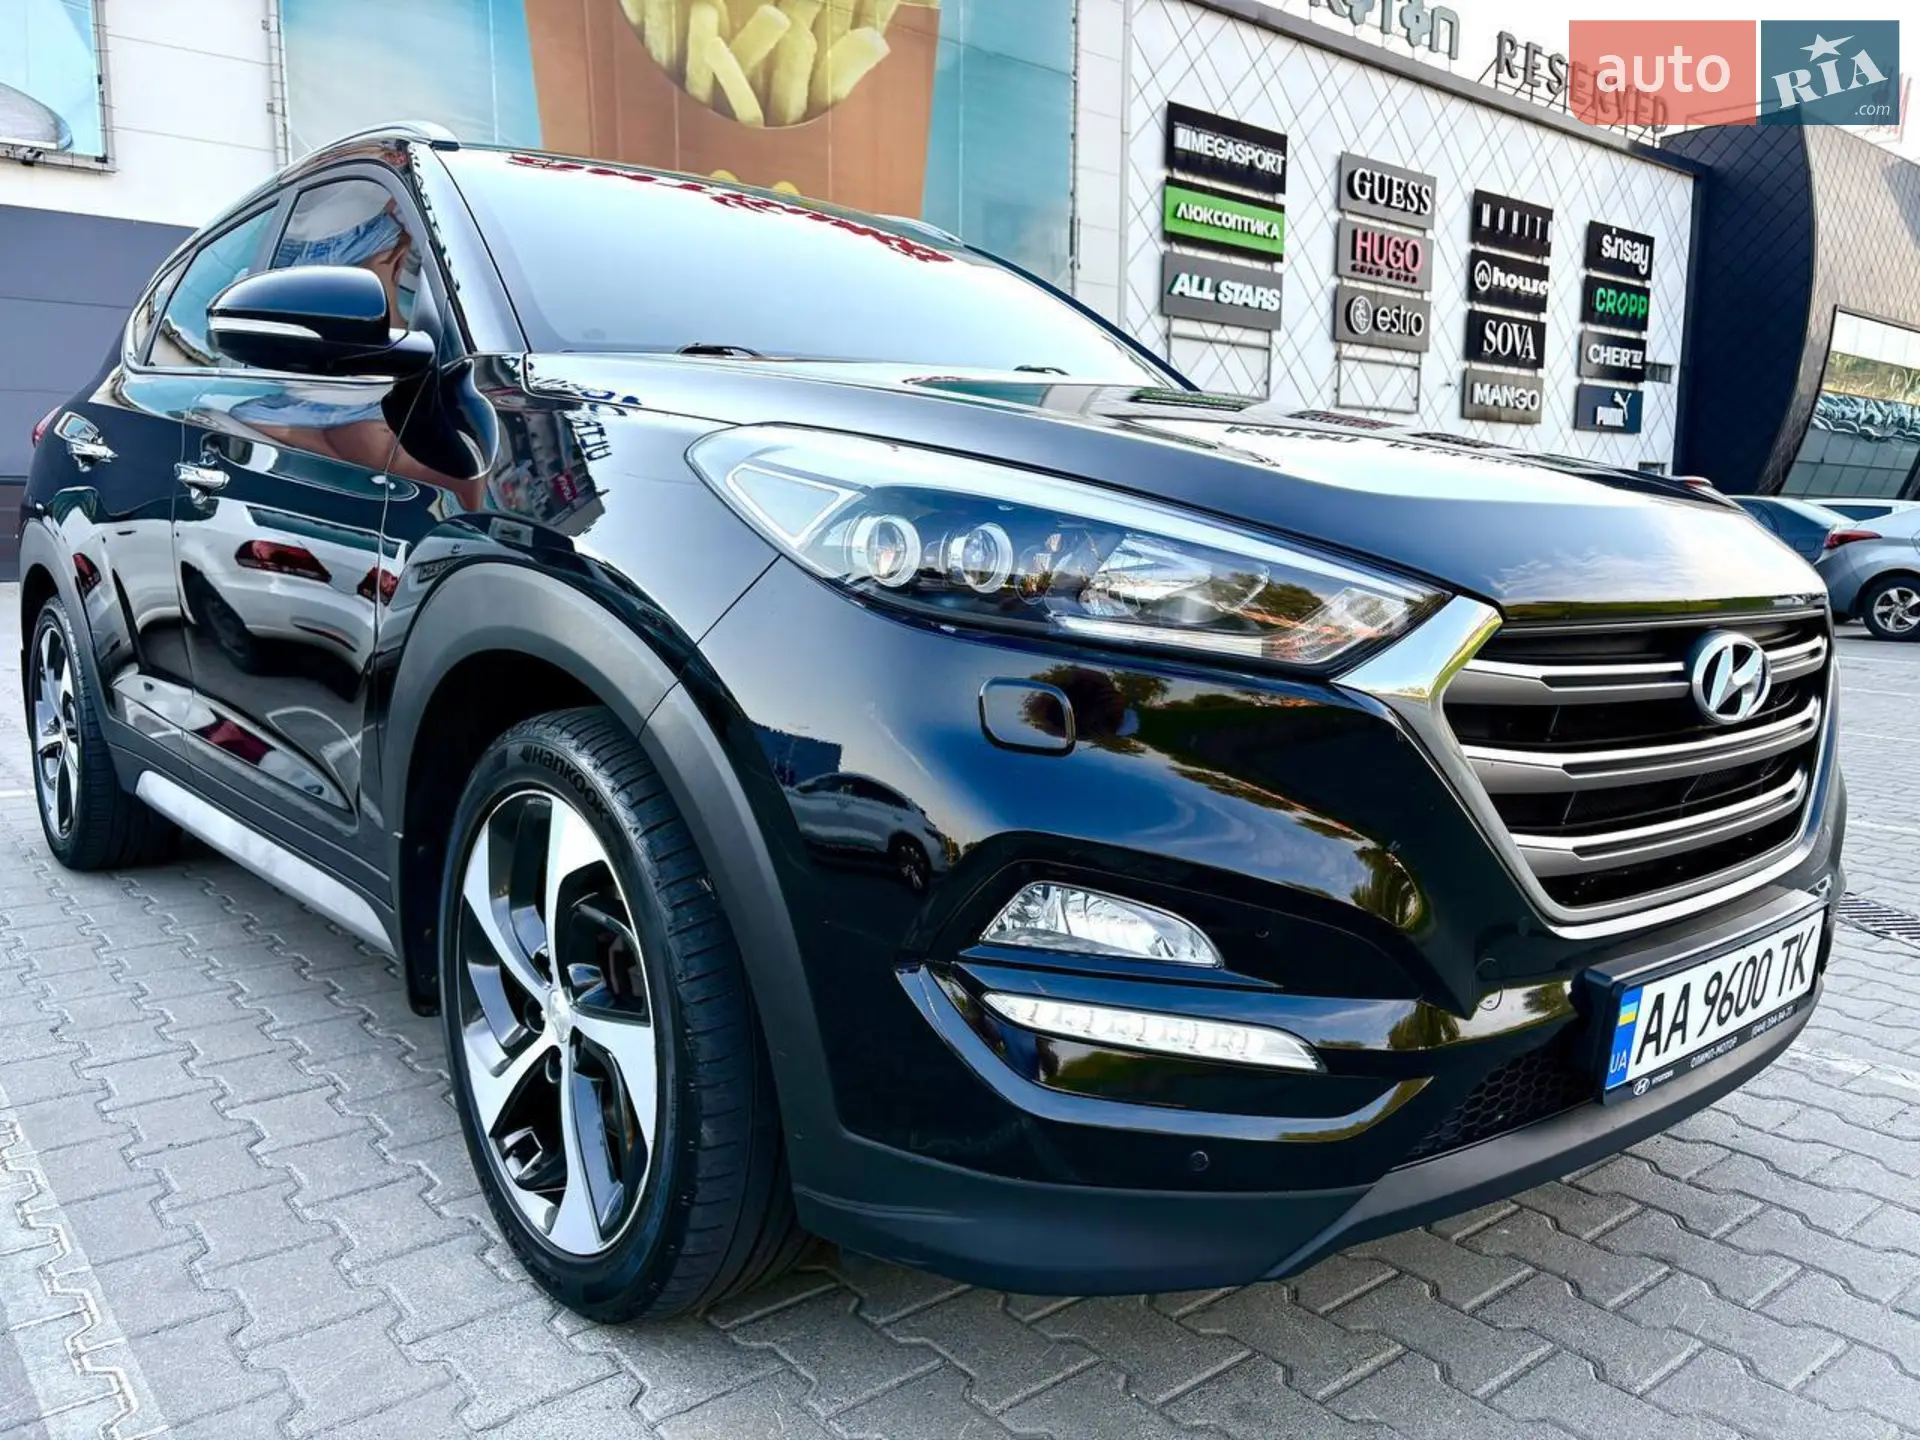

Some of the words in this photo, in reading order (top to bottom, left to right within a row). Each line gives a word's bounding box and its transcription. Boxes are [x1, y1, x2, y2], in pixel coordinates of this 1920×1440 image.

[1191, 131, 1286, 175] MEGASPORT
[1353, 167, 1432, 215] GUESS
[1177, 202, 1280, 239] ЛЮКСОПТИКА
[1355, 228, 1422, 272] HUGO
[1601, 228, 1649, 275] sinsay
[1171, 272, 1216, 301] ALL
[1217, 280, 1281, 312] STARS
[1595, 287, 1648, 319] CROPP
[1377, 304, 1424, 336] estro
[1483, 319, 1537, 360] SOVA
[1473, 382, 1540, 410] MANGO
[1635, 982, 1691, 1065] AA
[1697, 948, 1774, 1038] 9600
[1777, 925, 1816, 998] TK
[1609, 1049, 1627, 1073] UA
